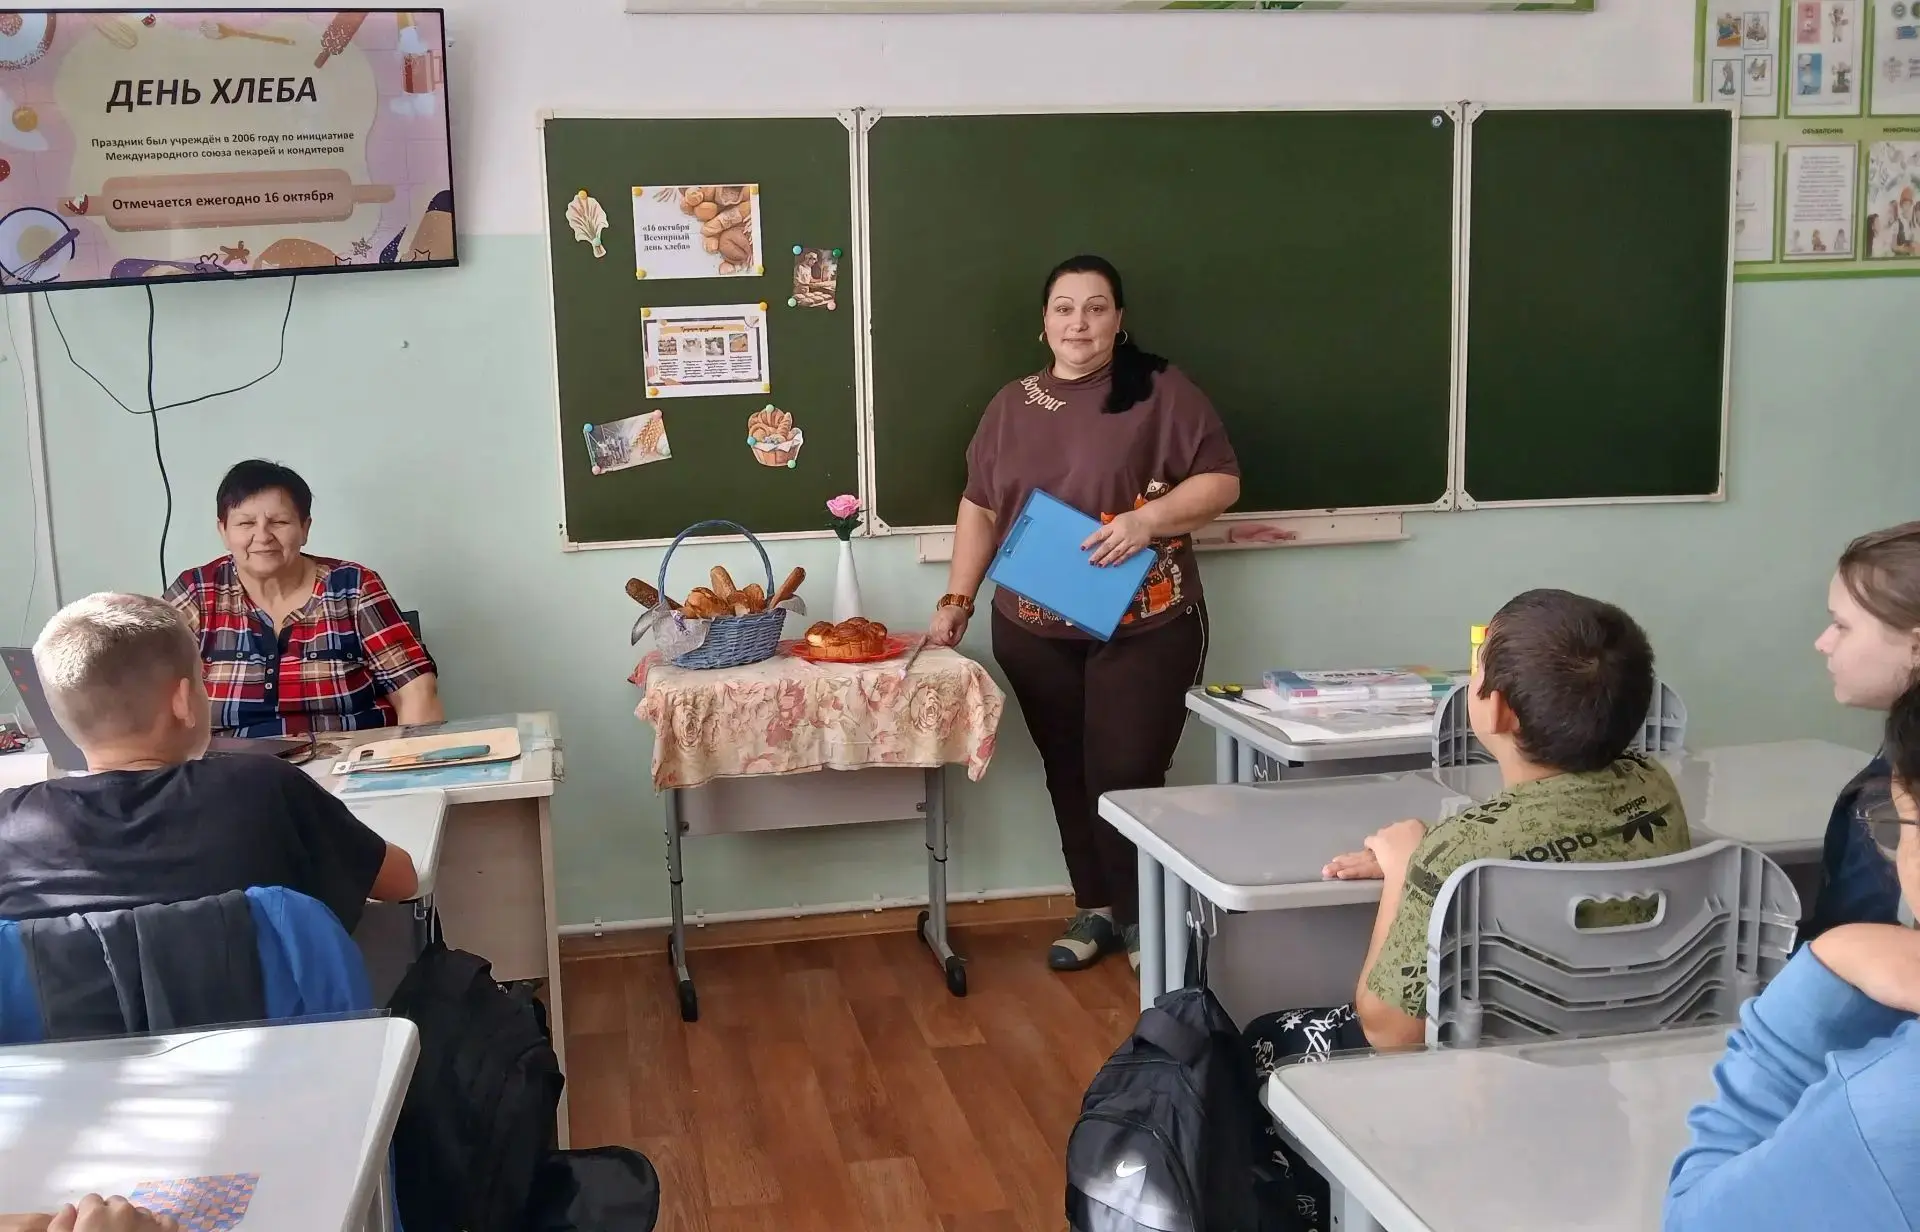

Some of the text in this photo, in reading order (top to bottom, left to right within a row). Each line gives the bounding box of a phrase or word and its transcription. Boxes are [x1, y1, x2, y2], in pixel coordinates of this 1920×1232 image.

[106, 77, 318, 113] ДЕНЬ ХЛЕБА
[91, 138, 144, 148] Праздник
[146, 136, 168, 146] был
[170, 134, 221, 146] учреждён
[232, 133, 256, 143] 2006
[258, 135, 280, 143] году
[296, 132, 355, 141] инициативе
[105, 150, 199, 161] Международного
[201, 150, 232, 158] союза
[234, 146, 276, 157] пекарей
[287, 145, 345, 156] кондитеров
[112, 190, 334, 210] Отмечается ежегодно 16 октября
[657, 223, 690, 233] октября
[643, 233, 690, 242] Всемирный
[644, 242, 691, 252] день хлеба»
[1020, 375, 1067, 412] Bonjour
[1613, 795, 1648, 817] adidas
